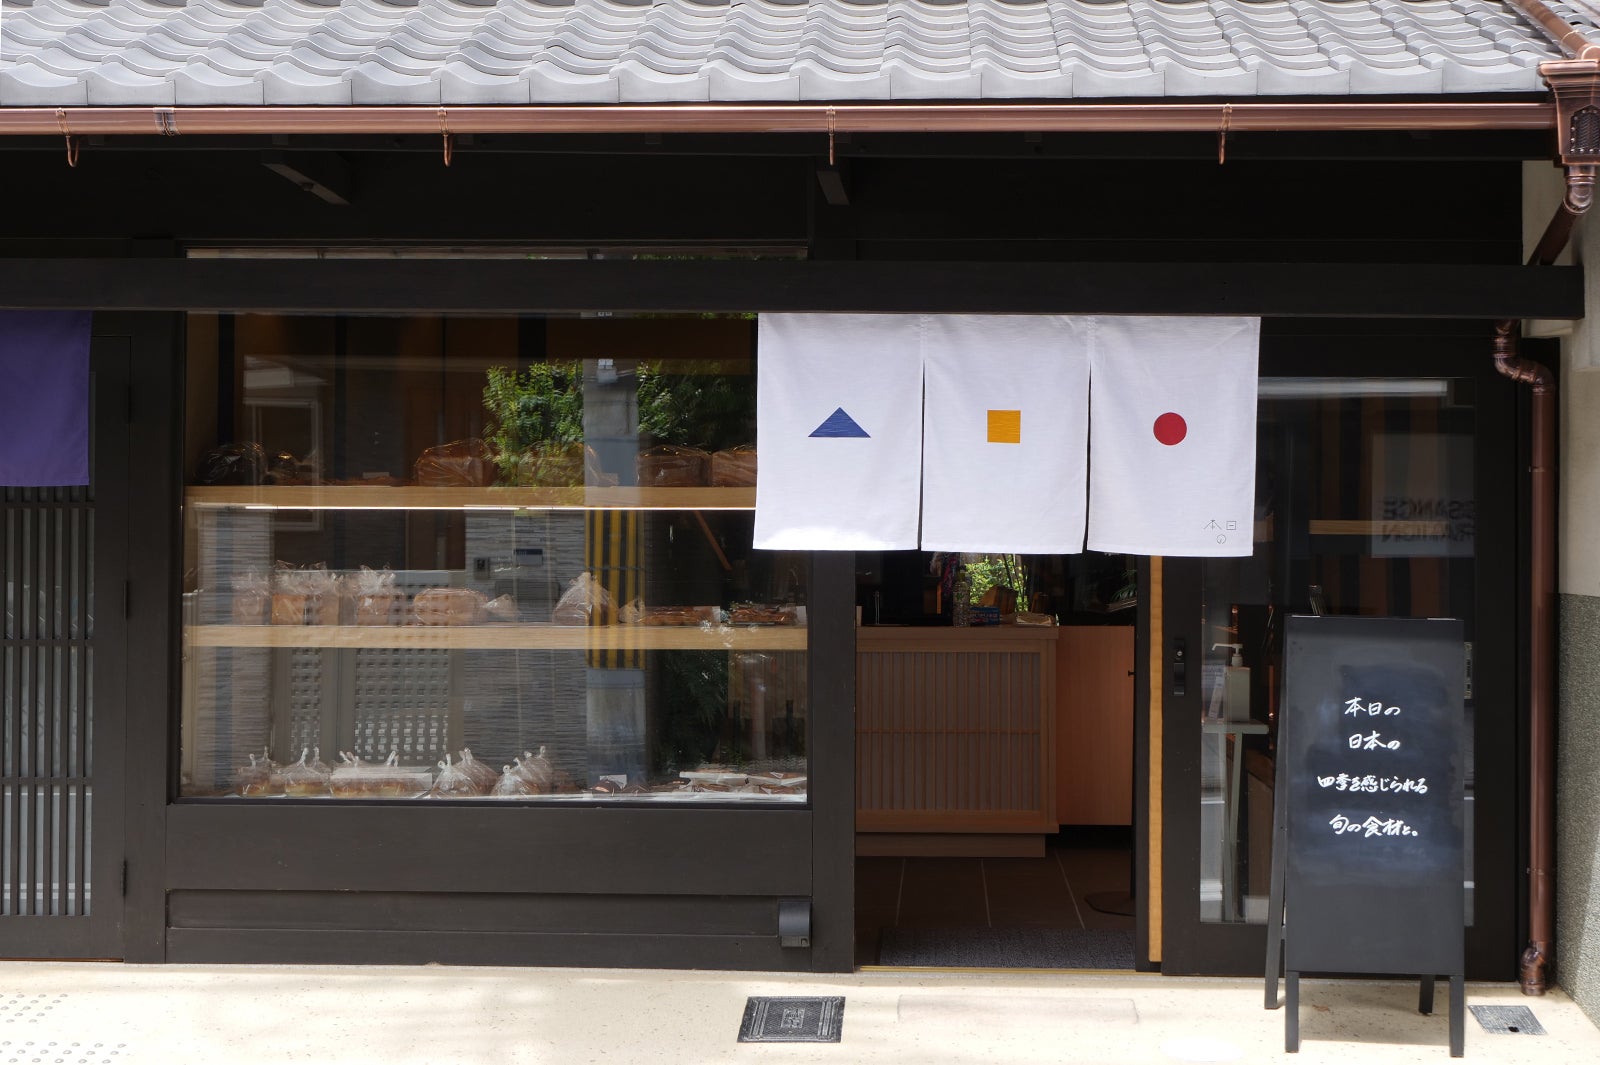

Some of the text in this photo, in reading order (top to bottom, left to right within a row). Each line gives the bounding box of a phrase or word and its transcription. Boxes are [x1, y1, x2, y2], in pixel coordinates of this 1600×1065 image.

[1344, 696, 1401, 718] 本日の
[1348, 730, 1401, 751] 日本の
[1317, 772, 1429, 794] 四季を感じられる
[1329, 813, 1419, 838] 旬の食材と。
